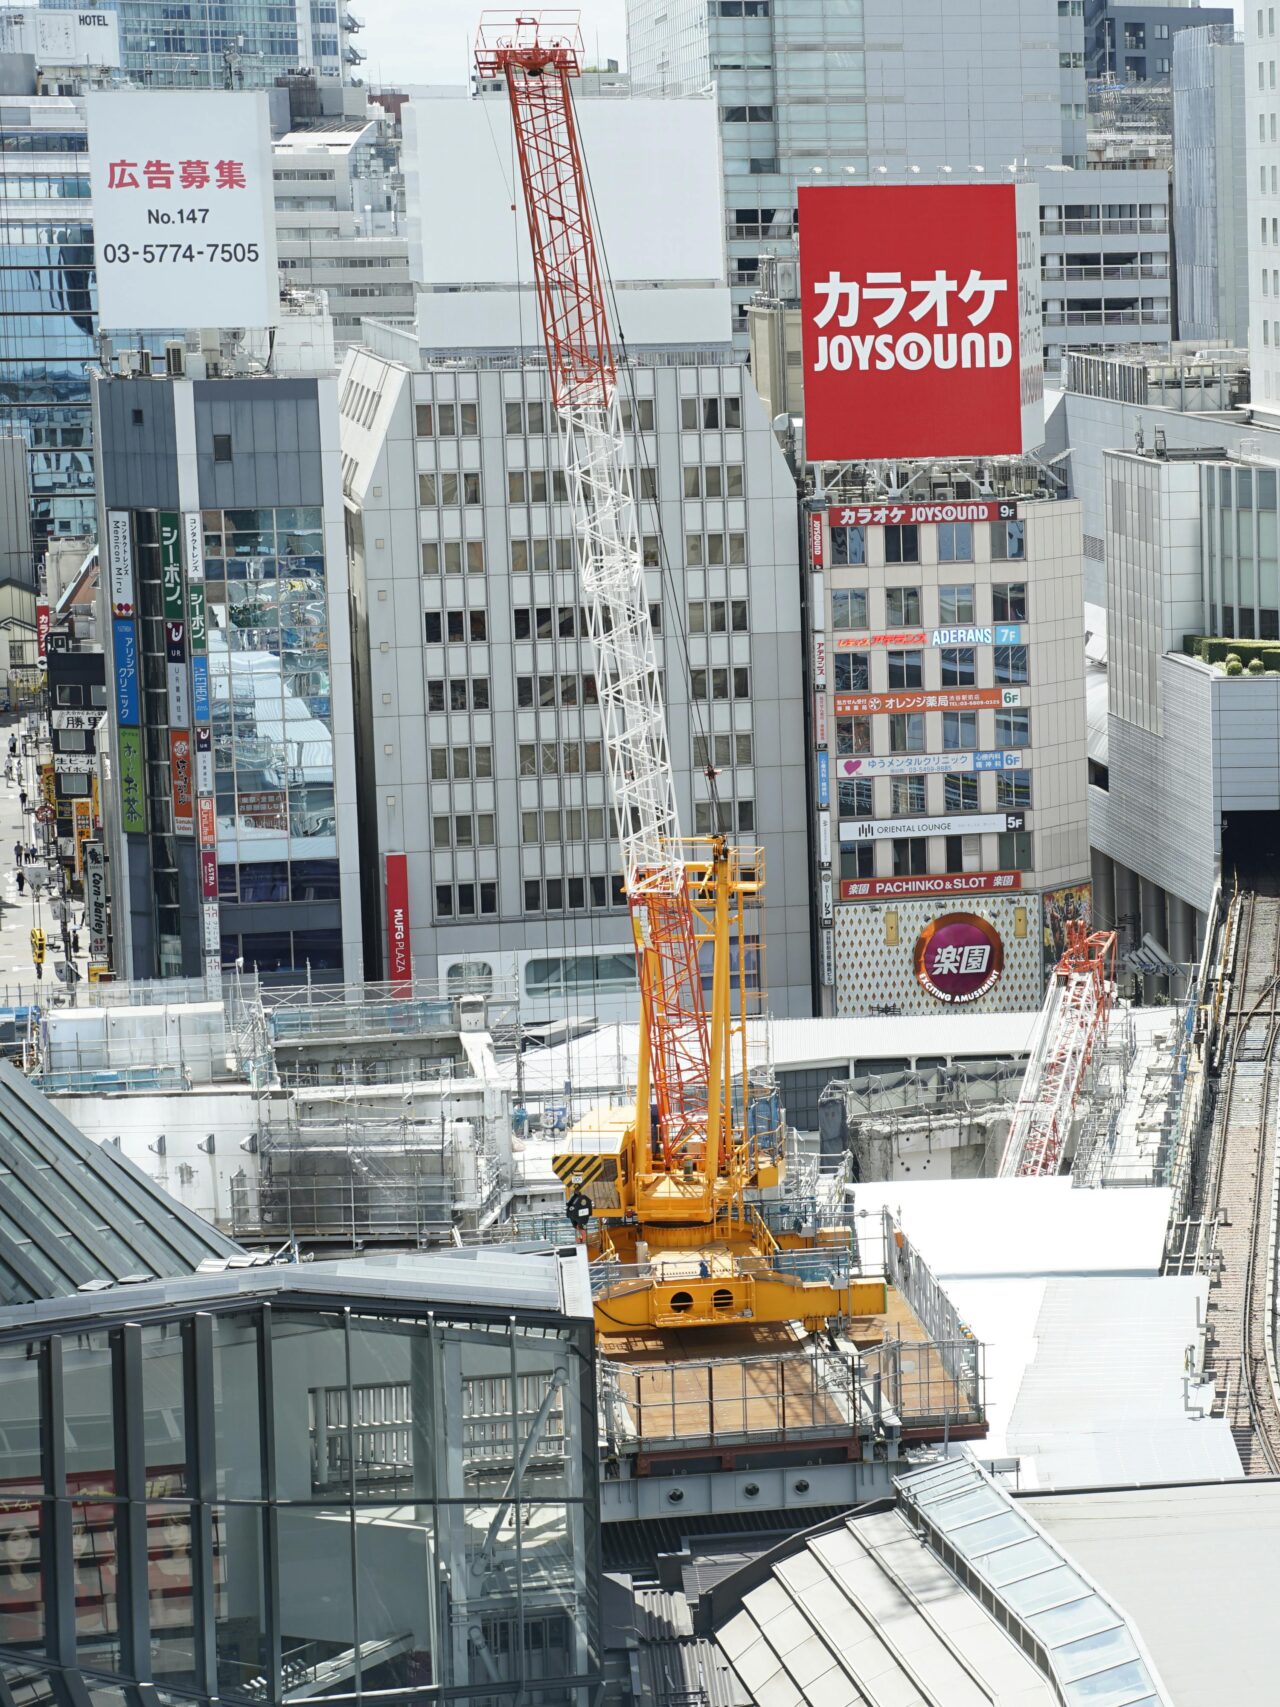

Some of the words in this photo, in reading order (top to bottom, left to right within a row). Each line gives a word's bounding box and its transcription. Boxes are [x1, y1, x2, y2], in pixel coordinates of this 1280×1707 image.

[79, 15, 108, 26] HOTEL
[107, 160, 247, 190] 広告募集
[147, 209, 209, 224] No.147
[103, 243, 259, 263] 03-5774-7505
[813, 270, 1007, 328] カラオケ
[814, 332, 1012, 371] JOYSOUND
[840, 507, 906, 525] カラオケ
[910, 505, 988, 522] JOYSOUND
[1000, 505, 1015, 517] 9F
[121, 521, 129, 575] コンタクトレンズ
[189, 518, 199, 572] コンタクトレンズ
[813, 520, 821, 556] JOYSOUND
[932, 628, 992, 647] ADERANS
[1001, 629, 1016, 642] 7F
[125, 637, 135, 678] アリシア
[816, 642, 825, 675] アデランス
[119, 668, 129, 718] クリニック
[885, 695, 949, 709] オレンジ薬局
[1004, 692, 1018, 704] 6F
[56, 757, 96, 765] 生ビール
[868, 755, 968, 768] ゆうメンタルクリニック
[1006, 754, 1020, 765] 6F
[877, 822, 916, 834] ORIENTAL
[918, 822, 951, 832] LOUNGE
[1007, 817, 1023, 829] 5F
[848, 884, 869, 895] 楽園
[993, 875, 1014, 887] 楽園
[92, 872, 105, 935] Corn-Barley
[394, 909, 404, 939] MUFG
[394, 941, 406, 973] PLAZA
[932, 945, 990, 975] 楽園
[919, 972, 952, 1002] EXCITING
[953, 969, 1000, 1003] AMUSEMENT
